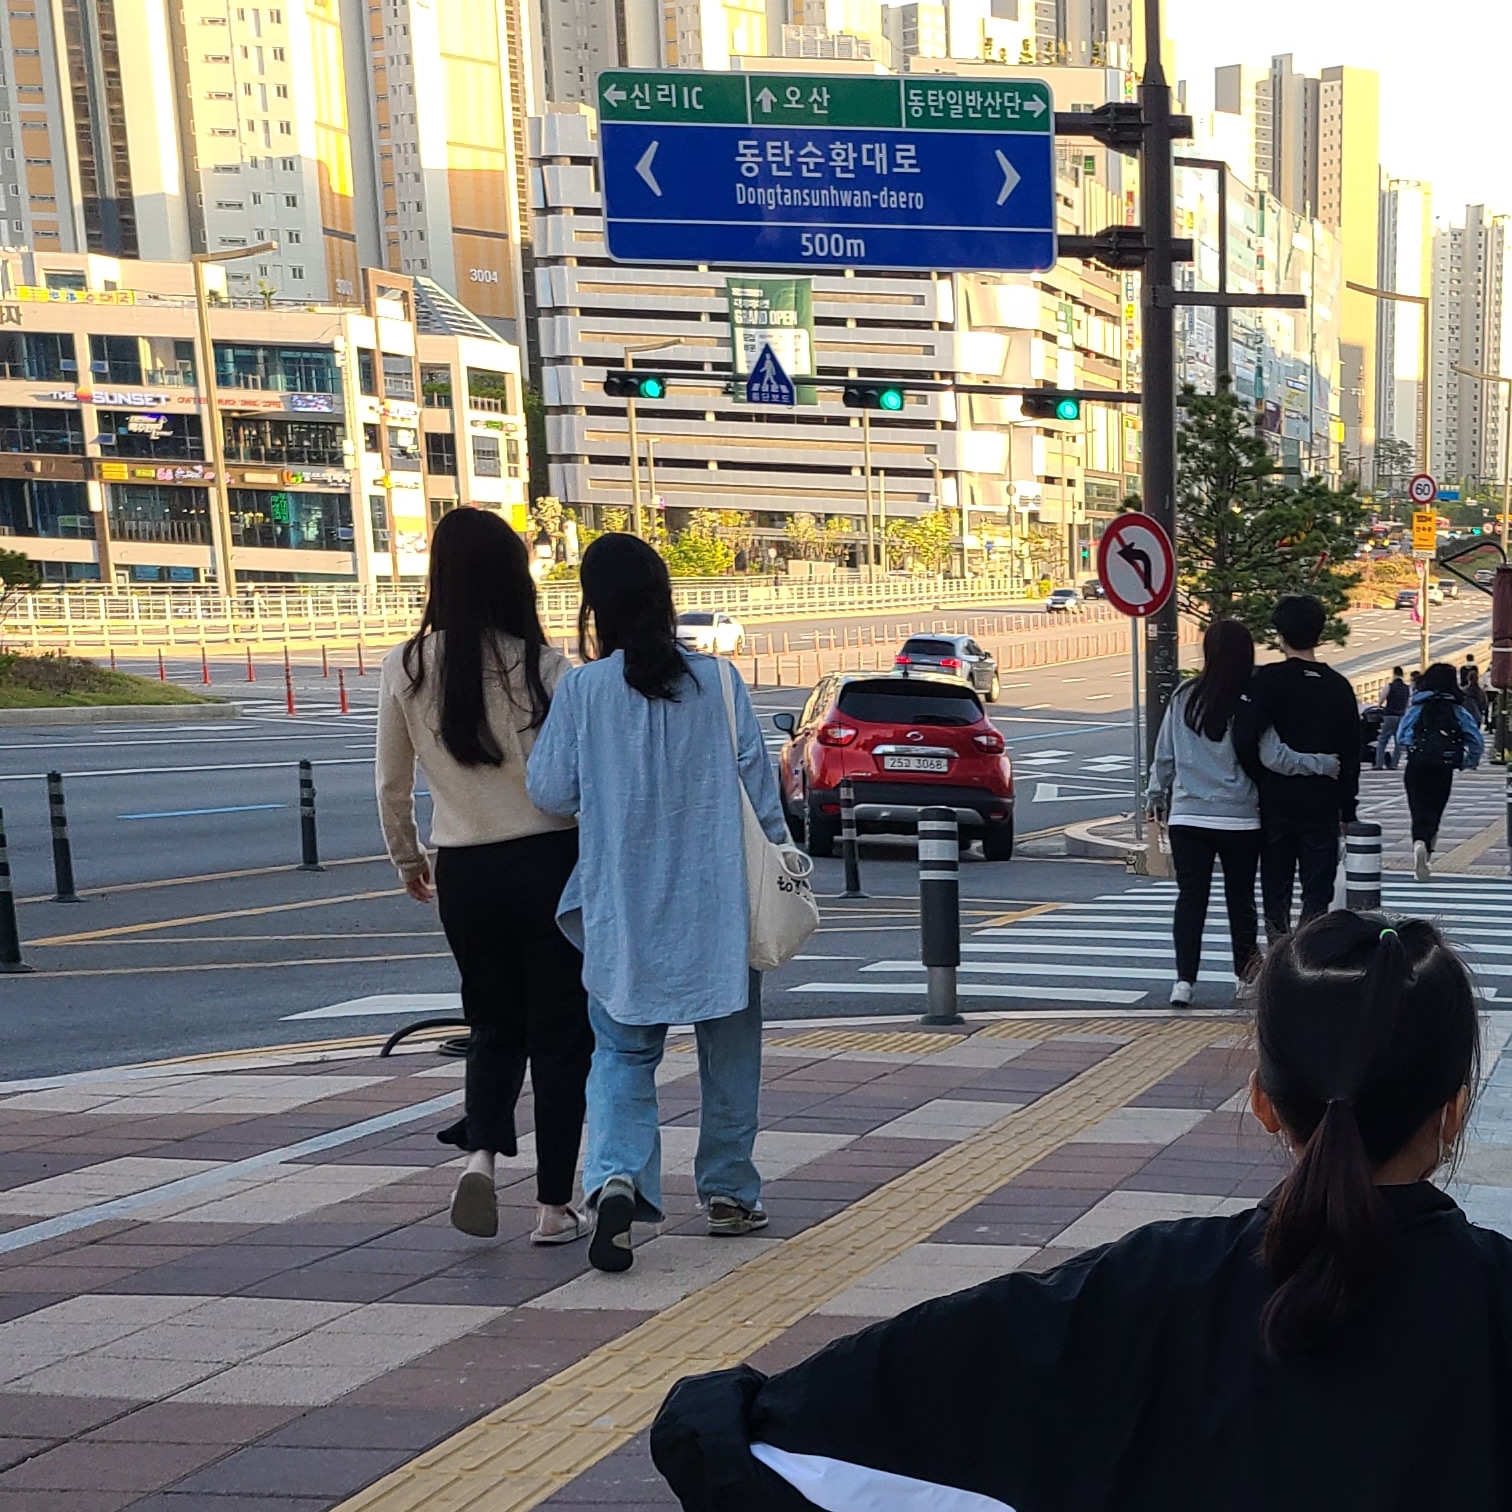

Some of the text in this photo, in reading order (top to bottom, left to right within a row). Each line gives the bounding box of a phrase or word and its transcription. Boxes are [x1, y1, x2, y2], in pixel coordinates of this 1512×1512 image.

[630, 83, 704, 111] 신리IC
[783, 86, 831, 115] 오산
[907, 88, 1022, 120] 동탄일반산단
[735, 140, 921, 179] 동탄순환대로
[735, 182, 924, 211] Dongtansunhwan-daero
[800, 233, 865, 258] 500m
[469, 268, 498, 284] 3004
[734, 309, 798, 325] GRAND OPEN
[50, 390, 171, 407] THE SUNSET
[1415, 483, 1431, 496] 60
